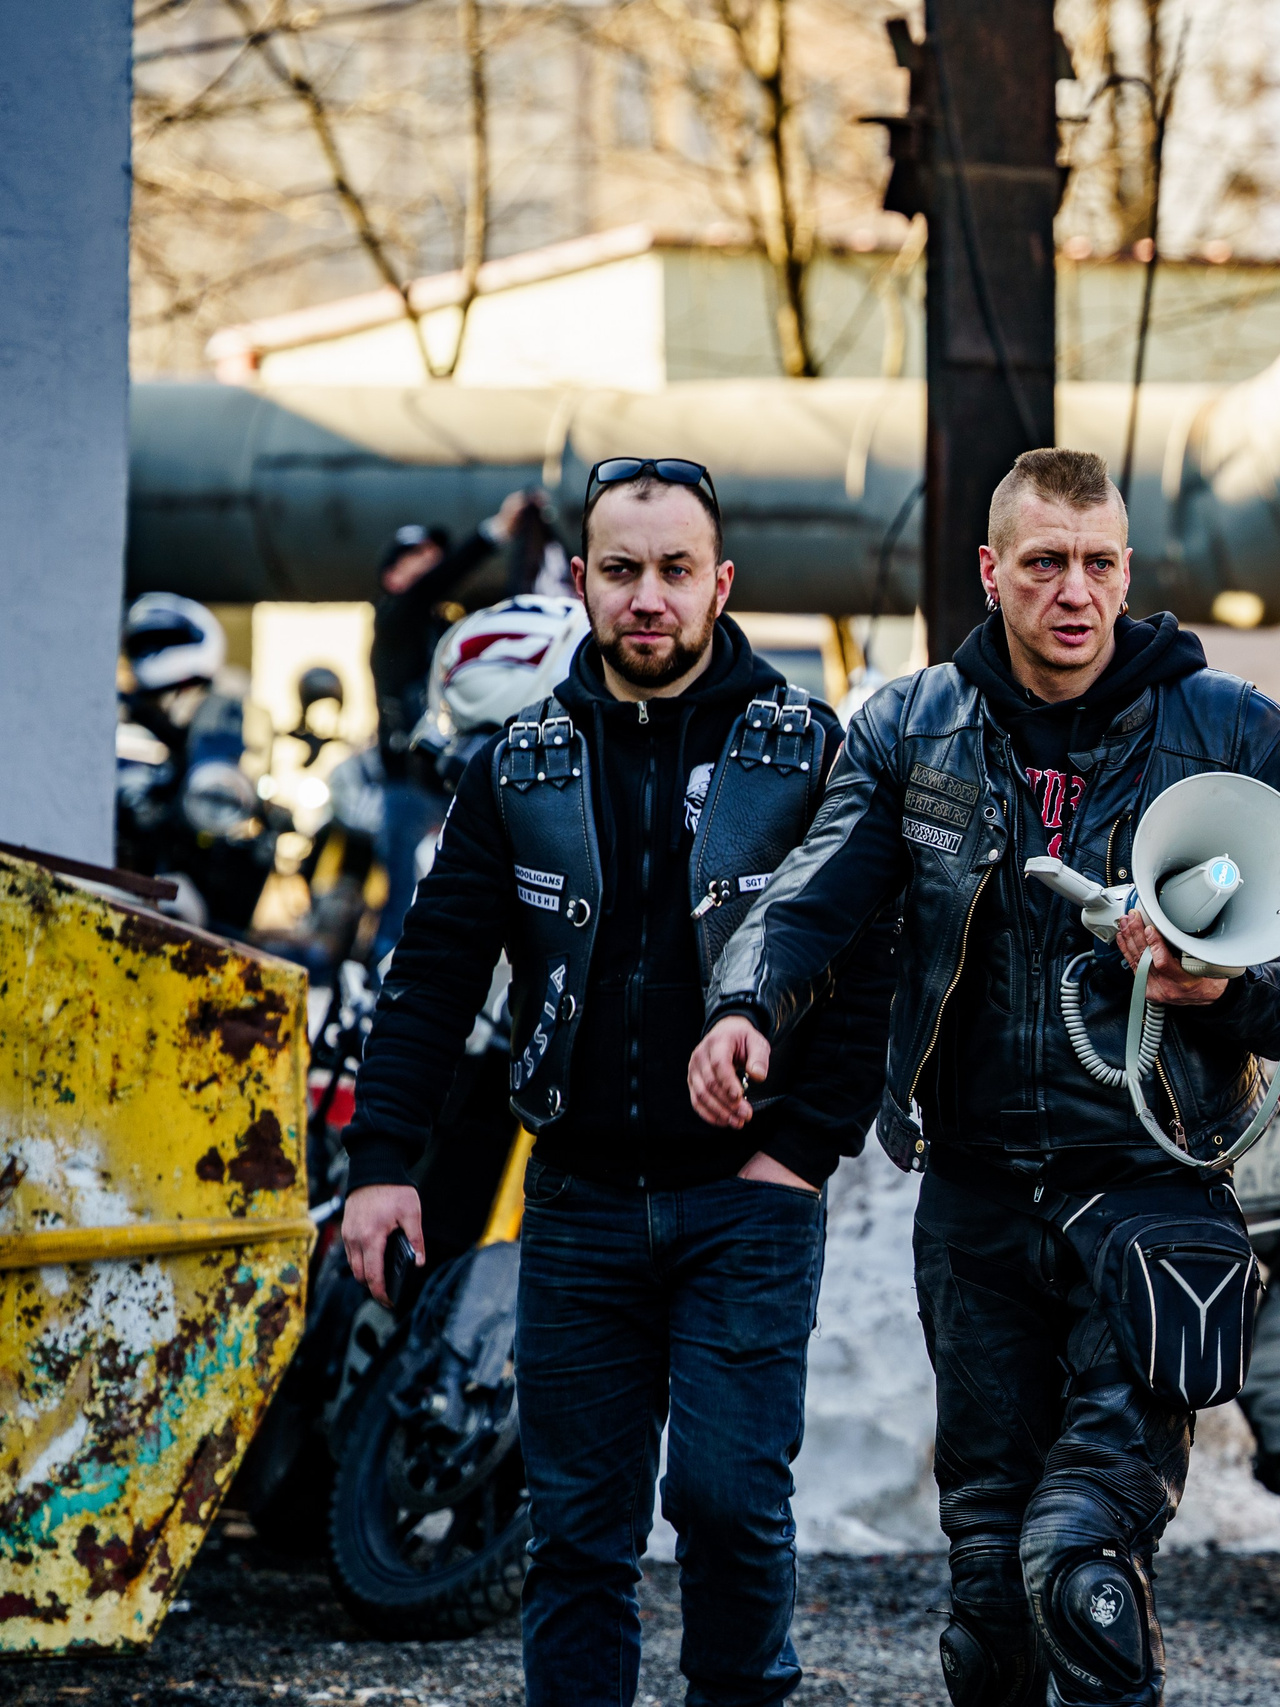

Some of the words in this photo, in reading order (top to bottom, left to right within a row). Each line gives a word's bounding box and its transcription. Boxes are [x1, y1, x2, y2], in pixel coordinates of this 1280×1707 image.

[515, 866, 561, 886] HOOLIGANS
[745, 877, 761, 888] SGT
[519, 889, 555, 908] KIRISHI
[513, 963, 566, 1090] USSIA
